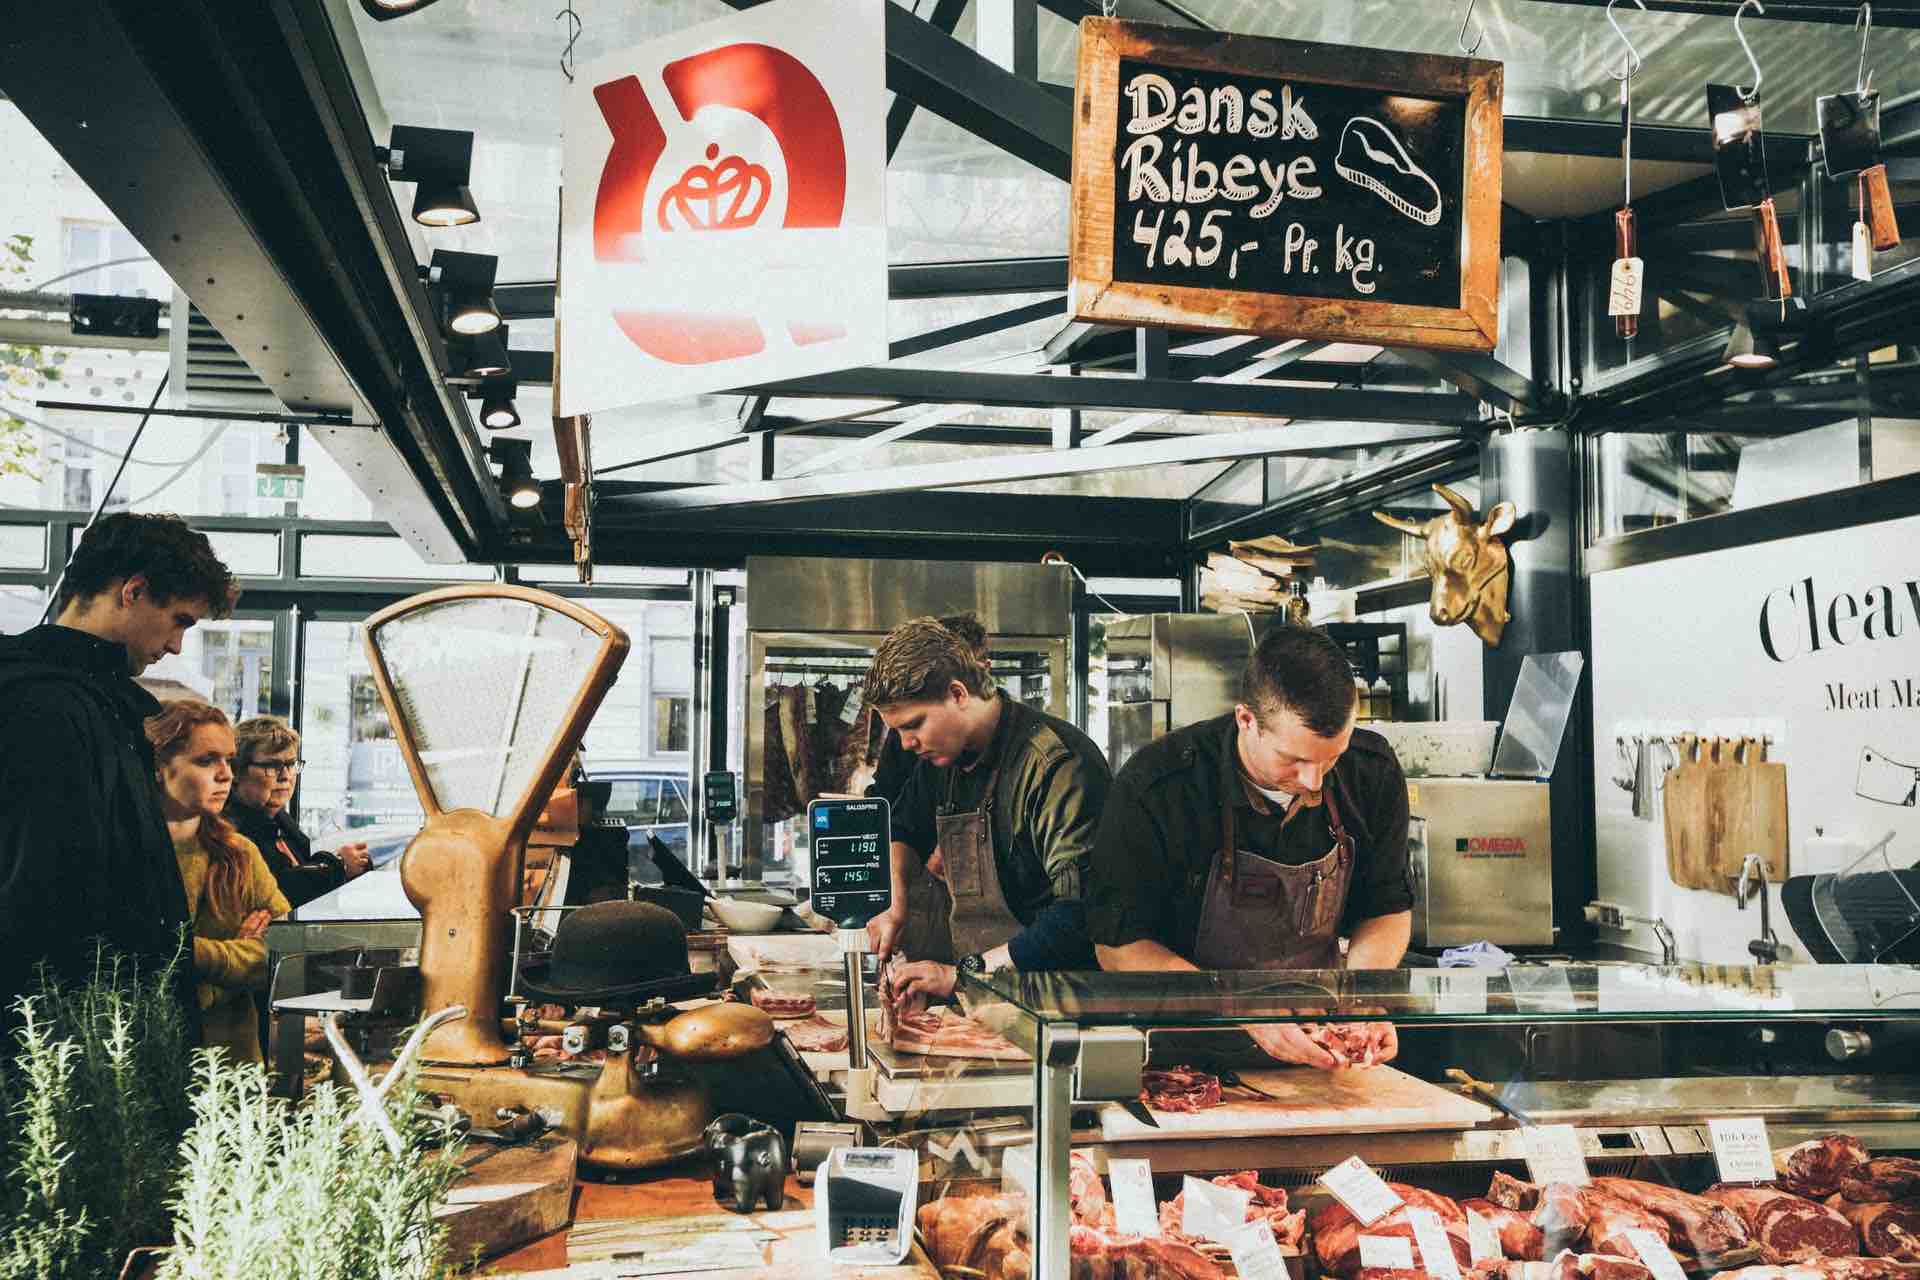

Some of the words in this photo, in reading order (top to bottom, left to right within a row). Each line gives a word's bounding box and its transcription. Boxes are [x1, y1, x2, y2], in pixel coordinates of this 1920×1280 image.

[1124, 73, 1319, 140] Dansk
[1121, 134, 1322, 219] Ribeye
[1132, 208, 1259, 280] 425,-
[1284, 221, 1319, 274] Pr.
[1335, 223, 1384, 294] kg.
[1825, 681, 1880, 710] Meat
